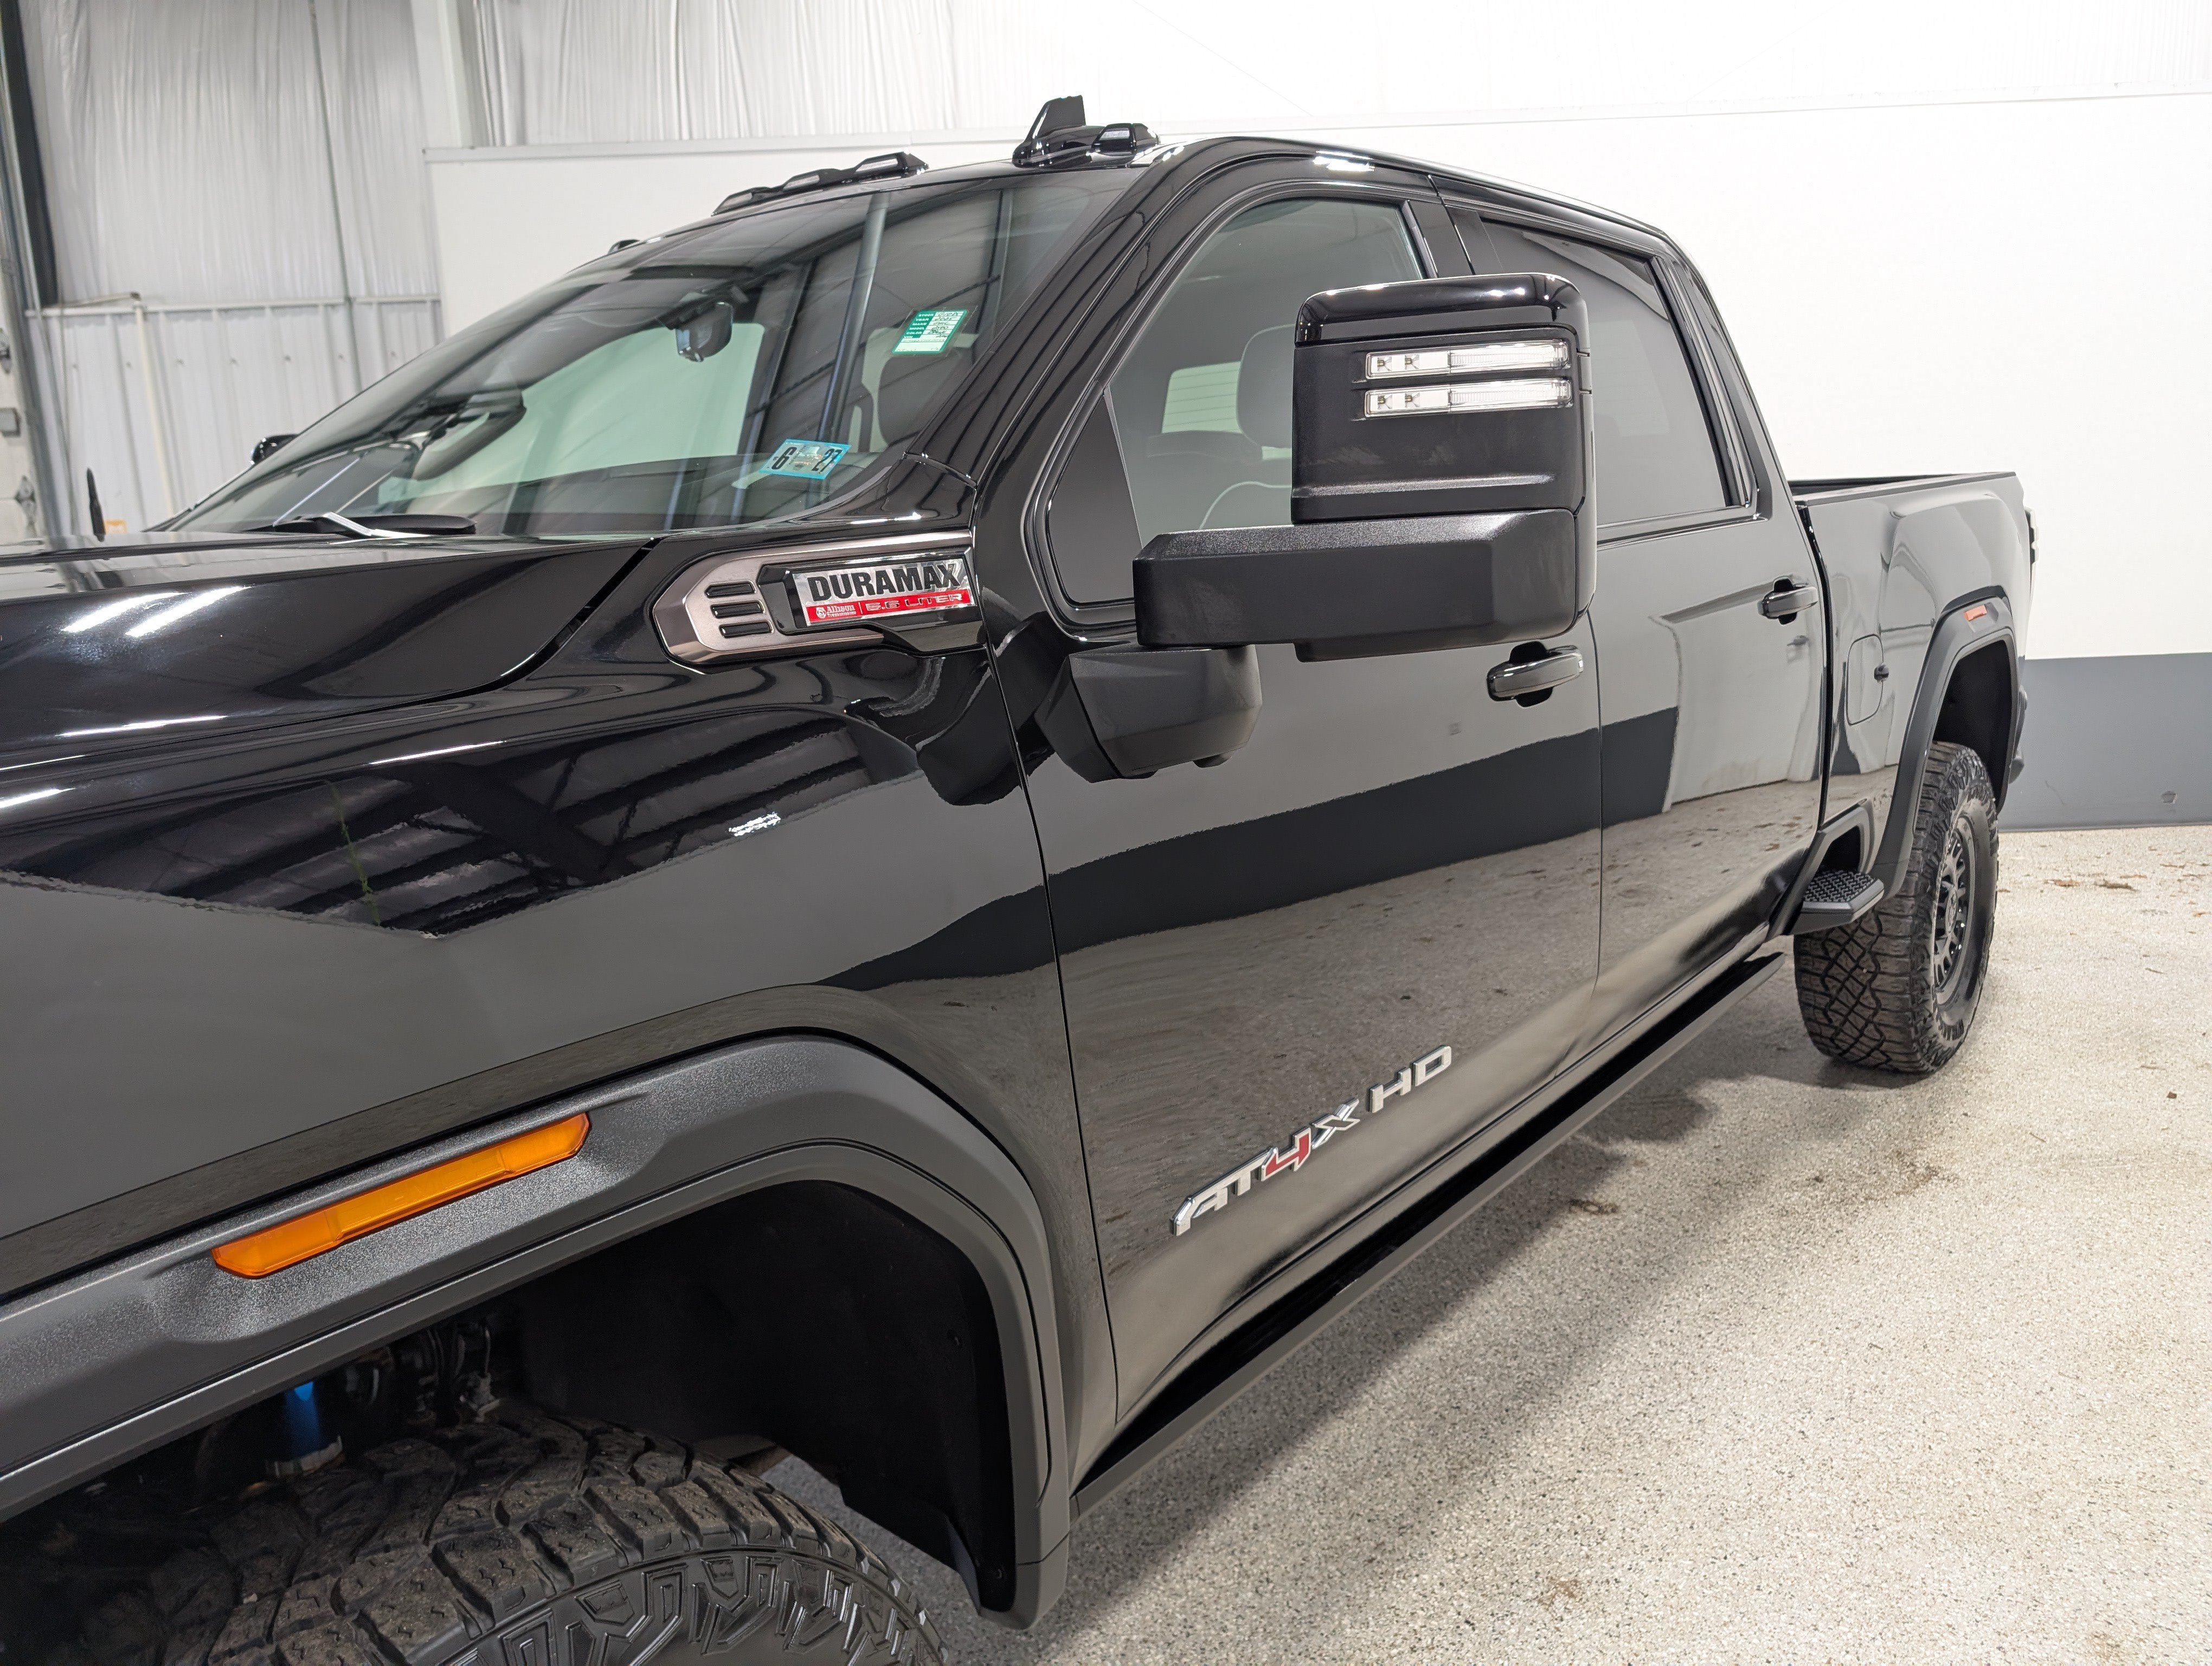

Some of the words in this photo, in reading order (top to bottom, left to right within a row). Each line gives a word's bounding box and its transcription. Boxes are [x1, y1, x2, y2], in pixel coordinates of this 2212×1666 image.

[771, 446, 798, 470] 6
[811, 448, 843, 472] 27
[807, 563, 963, 601] DURAMAX
[827, 605, 856, 613] Allison
[904, 594, 962, 607] LITER
[1172, 1099, 1361, 1236] AT4X
[1369, 1045, 1452, 1113] HD
